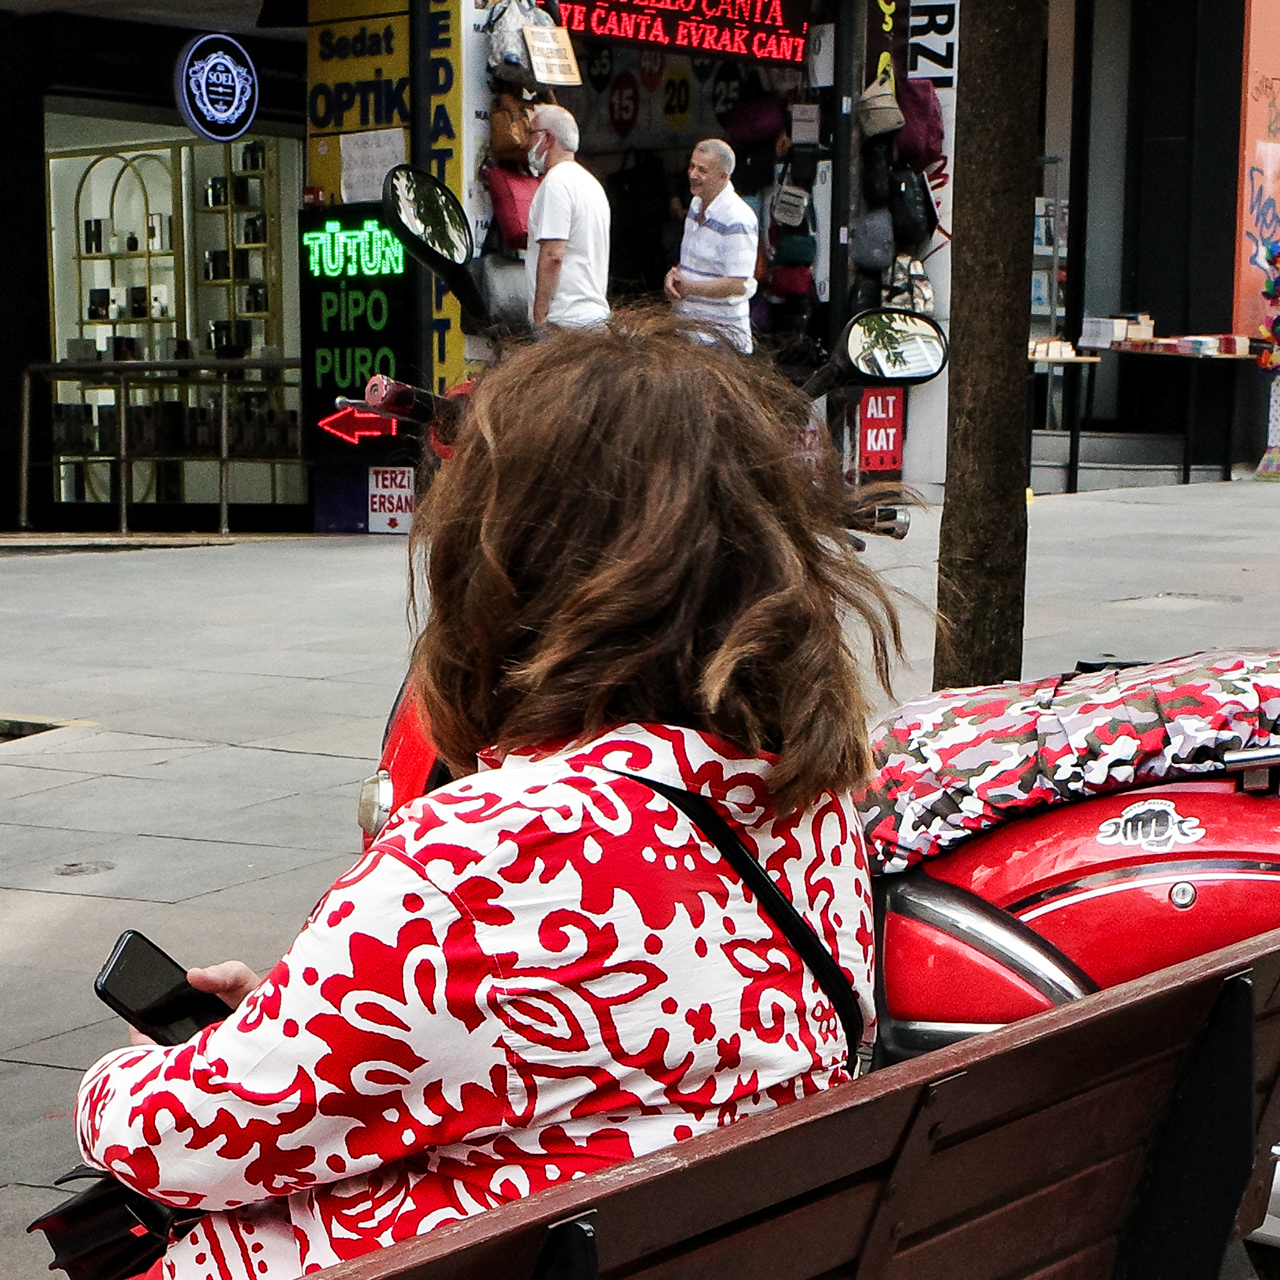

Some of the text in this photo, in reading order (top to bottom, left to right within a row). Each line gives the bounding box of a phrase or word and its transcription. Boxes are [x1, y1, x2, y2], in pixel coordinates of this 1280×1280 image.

[319, 24, 395, 61] Sedat
[675, 21, 748, 54] EVRAK
[208, 71, 235, 86] SOEL
[429, 0, 456, 188] EDAT
[664, 78, 690, 115] 20
[309, 67, 411, 129] OPTİK
[302, 219, 405, 278] TÜTÜN
[320, 280, 389, 332] PİPO
[314, 346, 396, 389] PURO
[866, 396, 896, 419] ALT
[866, 428, 896, 451] KAT
[370, 494, 414, 513] ERSAN
